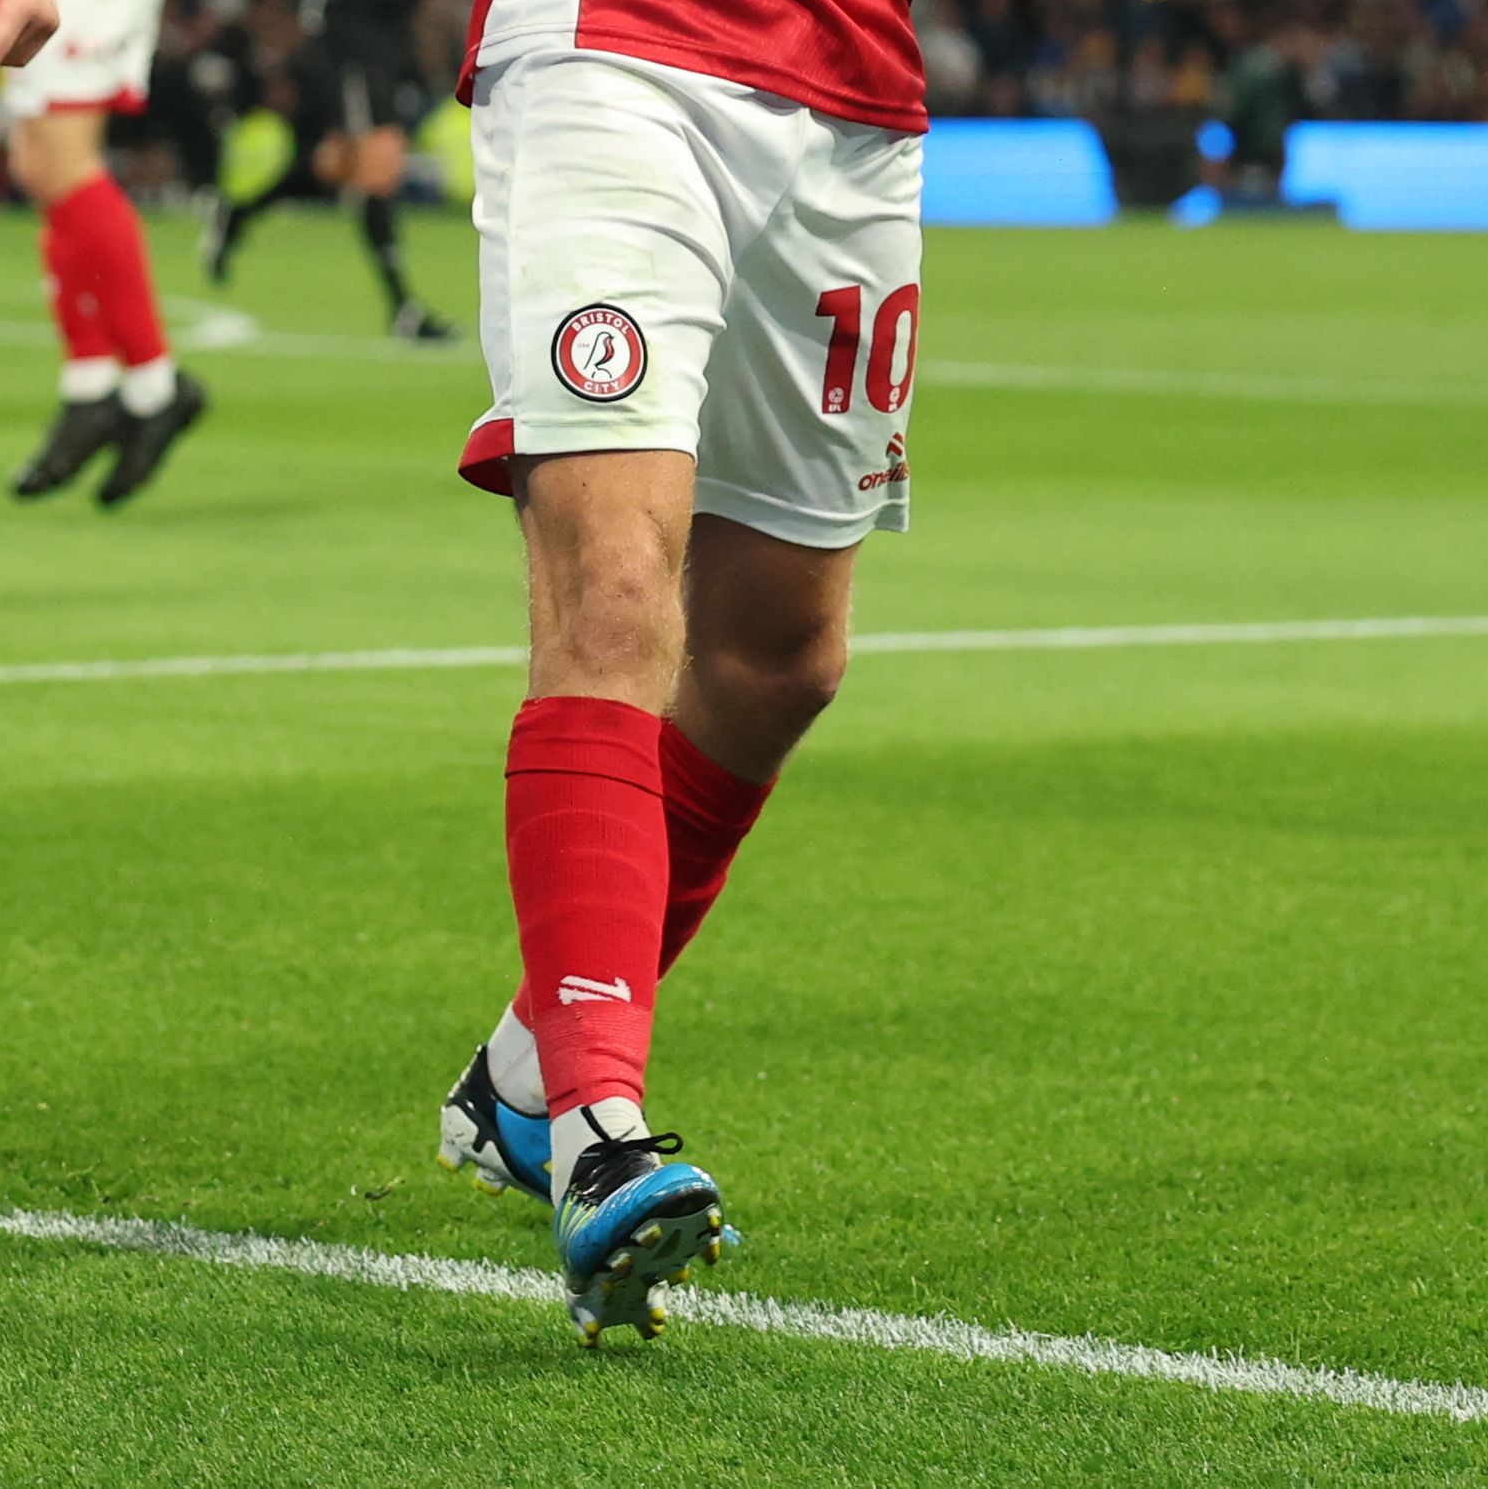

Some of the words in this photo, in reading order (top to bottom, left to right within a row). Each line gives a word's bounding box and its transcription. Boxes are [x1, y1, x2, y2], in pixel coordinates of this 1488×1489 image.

[572, 313, 630, 334] BRISTOL
[814, 282, 919, 414] 10
[584, 381, 620, 392] CITY
